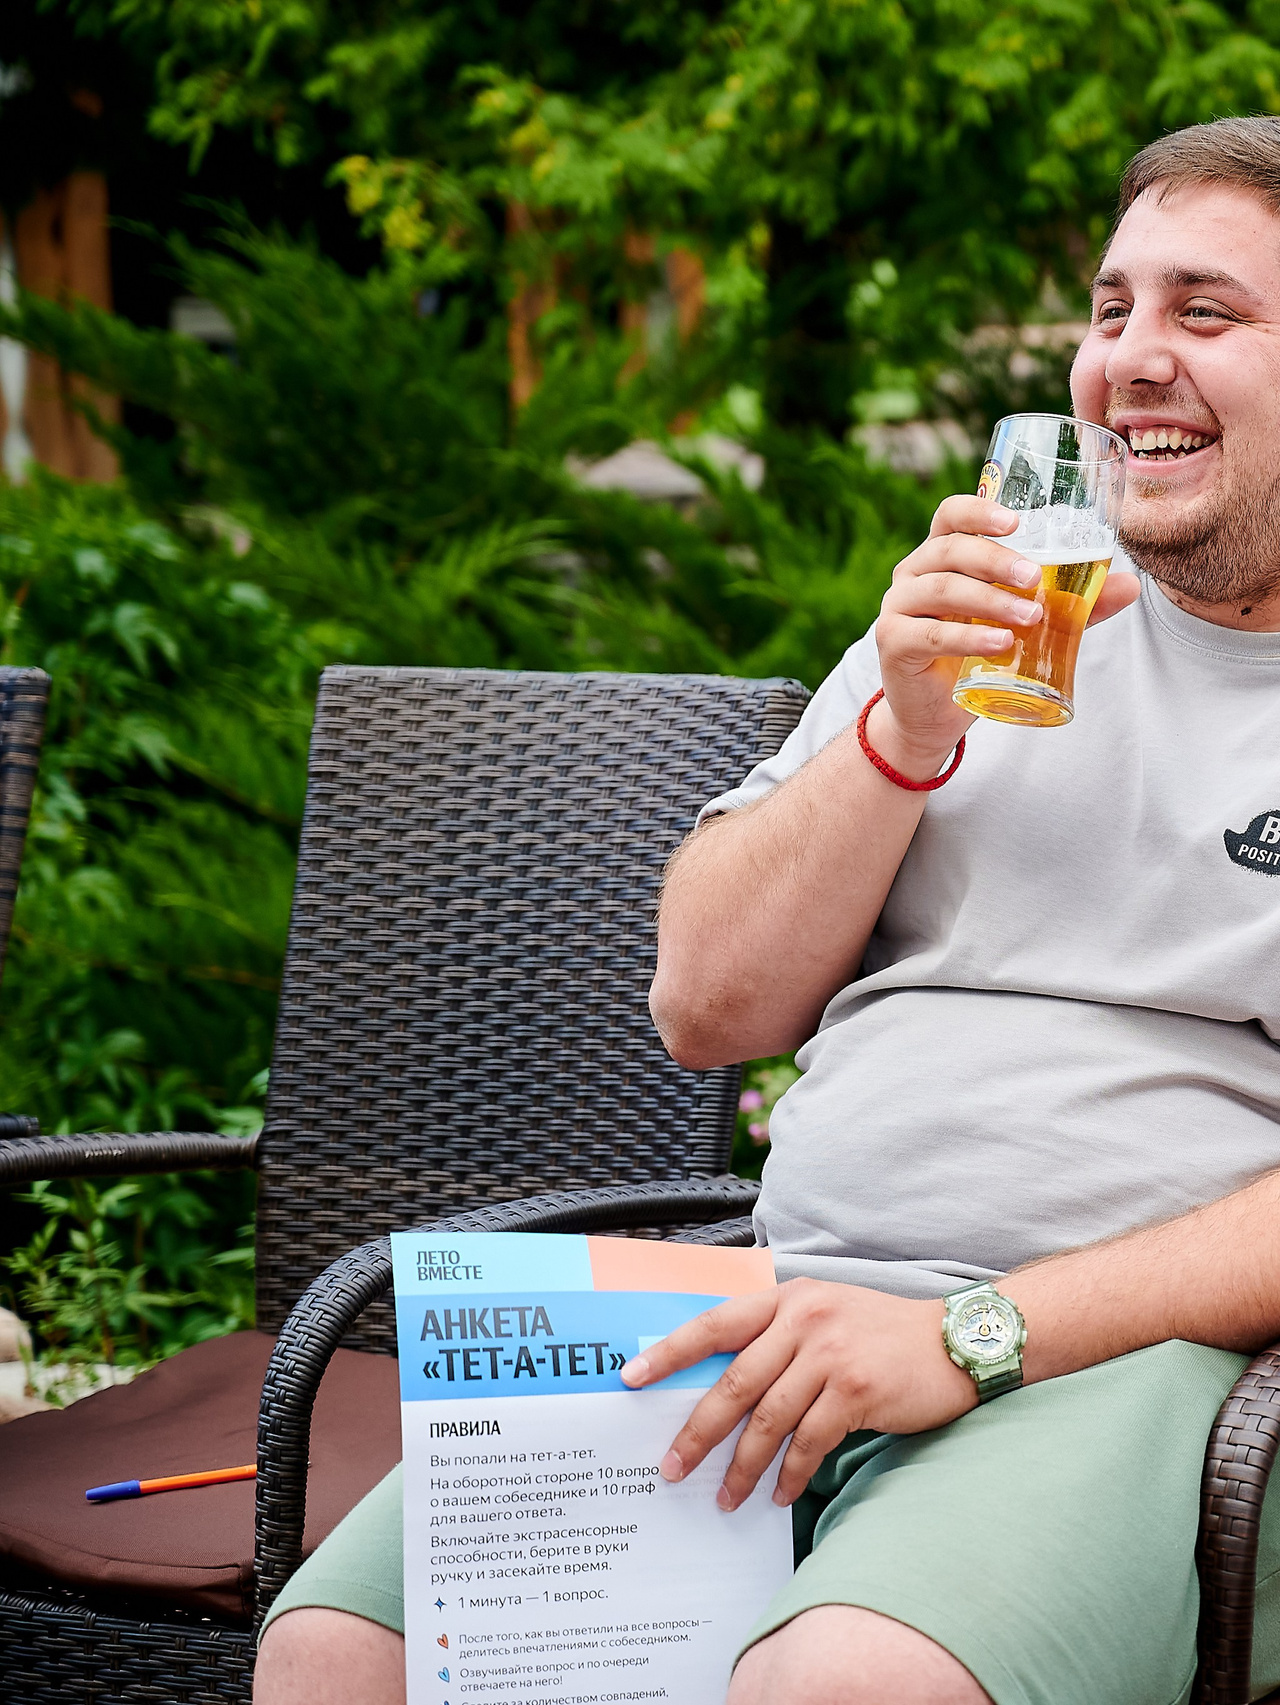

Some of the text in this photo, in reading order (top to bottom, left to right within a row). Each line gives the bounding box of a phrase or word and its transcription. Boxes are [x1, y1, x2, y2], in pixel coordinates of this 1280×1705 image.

[416, 1250, 461, 1266] ЛЕТО
[417, 1265, 483, 1281] ВМЕСТЕ
[420, 1306, 555, 1341] АНКЕТА
[422, 1342, 626, 1382] «ТЕТ-А-ТЕТ»
[429, 1420, 501, 1438] ПРАВИЛА
[430, 1448, 597, 1468] Вы попали на тет-а-тет.
[430, 1466, 660, 1491] На оборотной стороне 10 вопро
[429, 1497, 440, 1509] о
[442, 1495, 491, 1508] вашем
[494, 1487, 586, 1505] собеседнике
[589, 1487, 599, 1498] и
[601, 1482, 619, 1496] 10
[621, 1479, 656, 1497] граф
[429, 1507, 566, 1528] для вашего ответа.
[431, 1524, 637, 1548] Включайте экстрасенсорные
[529, 1544, 581, 1560] берите
[583, 1544, 592, 1555] в
[594, 1541, 629, 1557] руки
[430, 1560, 613, 1587] ручку и засекайте время.
[457, 1596, 465, 1609] 1
[469, 1594, 522, 1610] минута
[542, 1590, 549, 1603] 1
[553, 1588, 609, 1604] вопрос.
[458, 1633, 494, 1645] После
[524, 1630, 544, 1640] как
[545, 1629, 561, 1639] вы
[561, 1625, 614, 1637] ответили
[615, 1624, 629, 1633] на
[630, 1622, 650, 1632] все
[651, 1619, 700, 1631] вопросы
[458, 1633, 692, 1661] делитесь впечатлениями с собеседником.
[459, 1656, 650, 1680] Озвучивайте вопрос и по очереди
[459, 1674, 563, 1693] отвечаете на него!
[526, 1695, 598, 1705] количеством
